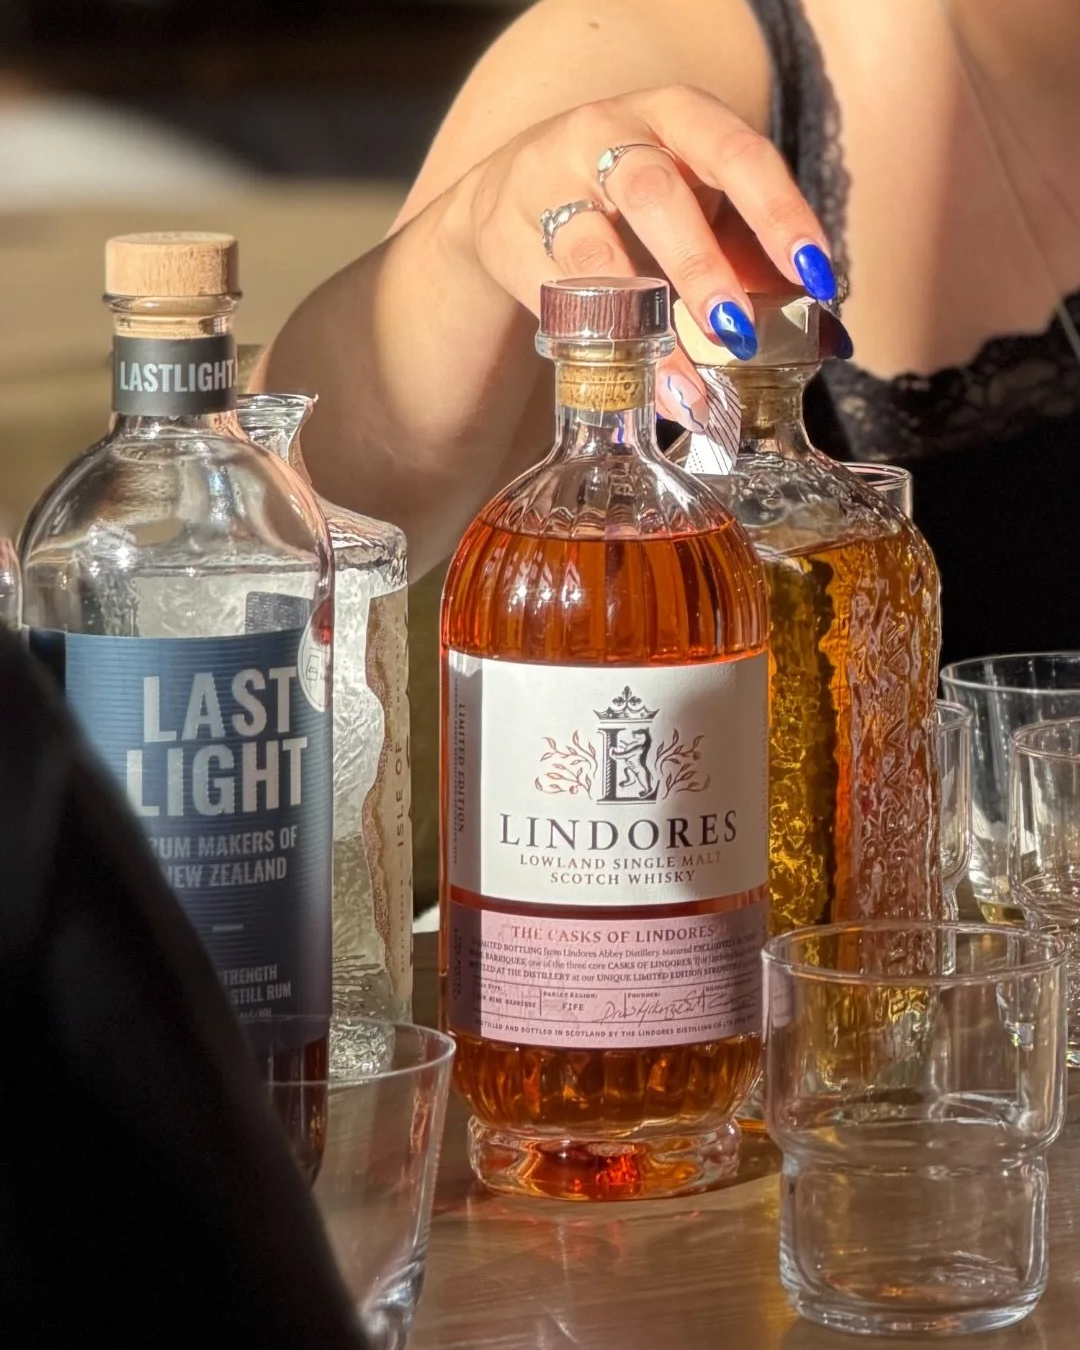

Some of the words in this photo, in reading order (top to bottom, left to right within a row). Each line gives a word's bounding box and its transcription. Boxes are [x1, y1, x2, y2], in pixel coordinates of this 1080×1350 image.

[143, 666, 297, 743] LAST
[458, 703, 466, 766] LIMITED
[126, 736, 308, 817] LIGHT
[457, 771, 465, 833] EDITION
[198, 830, 275, 858] MAKERS
[280, 825, 297, 850] OF
[500, 810, 737, 851] LINDORES
[209, 857, 287, 887] ZEALAND
[520, 853, 605, 870] LOWLAND
[613, 856, 676, 869] SINGLE
[682, 851, 721, 868] MALT
[551, 872, 619, 885] SCOTCH
[628, 870, 696, 885] WHISKY
[512, 925, 543, 940] THE
[547, 930, 601, 943] CASKS
[607, 931, 630, 943] OF
[635, 924, 715, 942] LINDORES
[219, 964, 278, 986] TRENGTH
[266, 980, 292, 1001] RUM
[562, 1003, 584, 1011] FIFE
